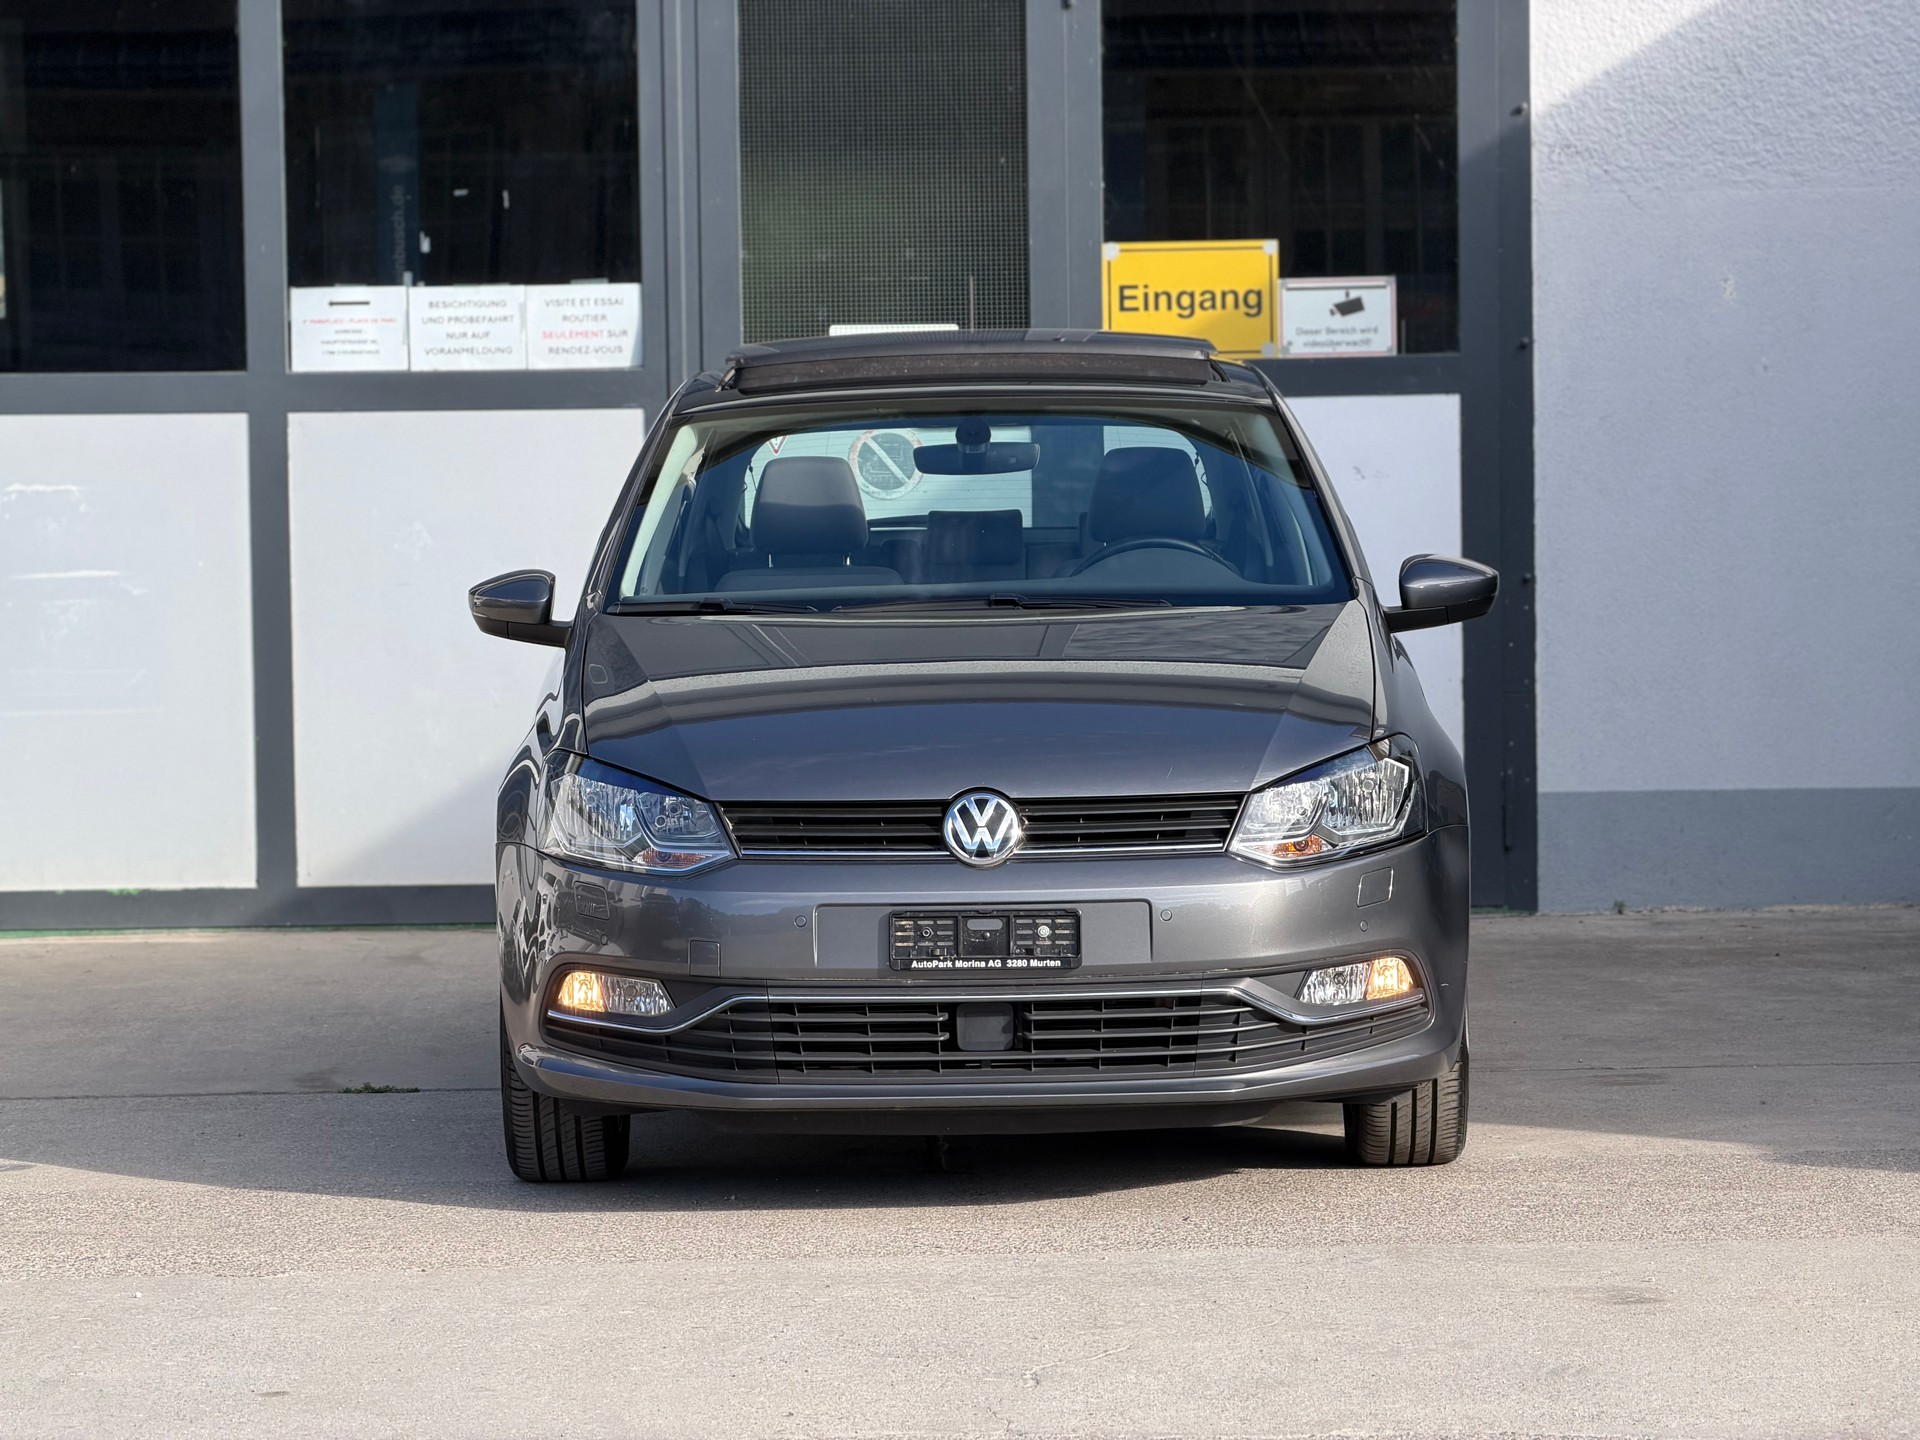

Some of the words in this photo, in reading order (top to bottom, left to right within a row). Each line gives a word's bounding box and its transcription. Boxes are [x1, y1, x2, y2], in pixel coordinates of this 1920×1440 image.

[428, 299, 507, 309] BESICHTIGUNG
[544, 298, 576, 307] VISITE
[579, 298, 591, 307] ET
[594, 297, 624, 306] ESSAI
[1118, 284, 1263, 319] Eingang
[421, 316, 445, 325] UND
[447, 315, 514, 324] PROBEFAHRT
[561, 314, 608, 323] ROUTIER
[446, 332, 468, 340] NUR
[471, 331, 491, 340] AUF
[542, 329, 604, 339] SEULEMENT
[607, 329, 629, 338] SUR
[1295, 327, 1323, 336] Dieser
[1325, 326, 1357, 335] Bereich
[1359, 325, 1379, 334] wird
[424, 346, 513, 356] VORANMELDUNG
[548, 345, 624, 355] RENDEZ-VOUS
[911, 958, 953, 969] AutoPark
[955, 958, 985, 969] Morina
[987, 958, 1002, 968] AG
[1006, 958, 1028, 968] 3280
[1030, 958, 1061, 968] Murten
